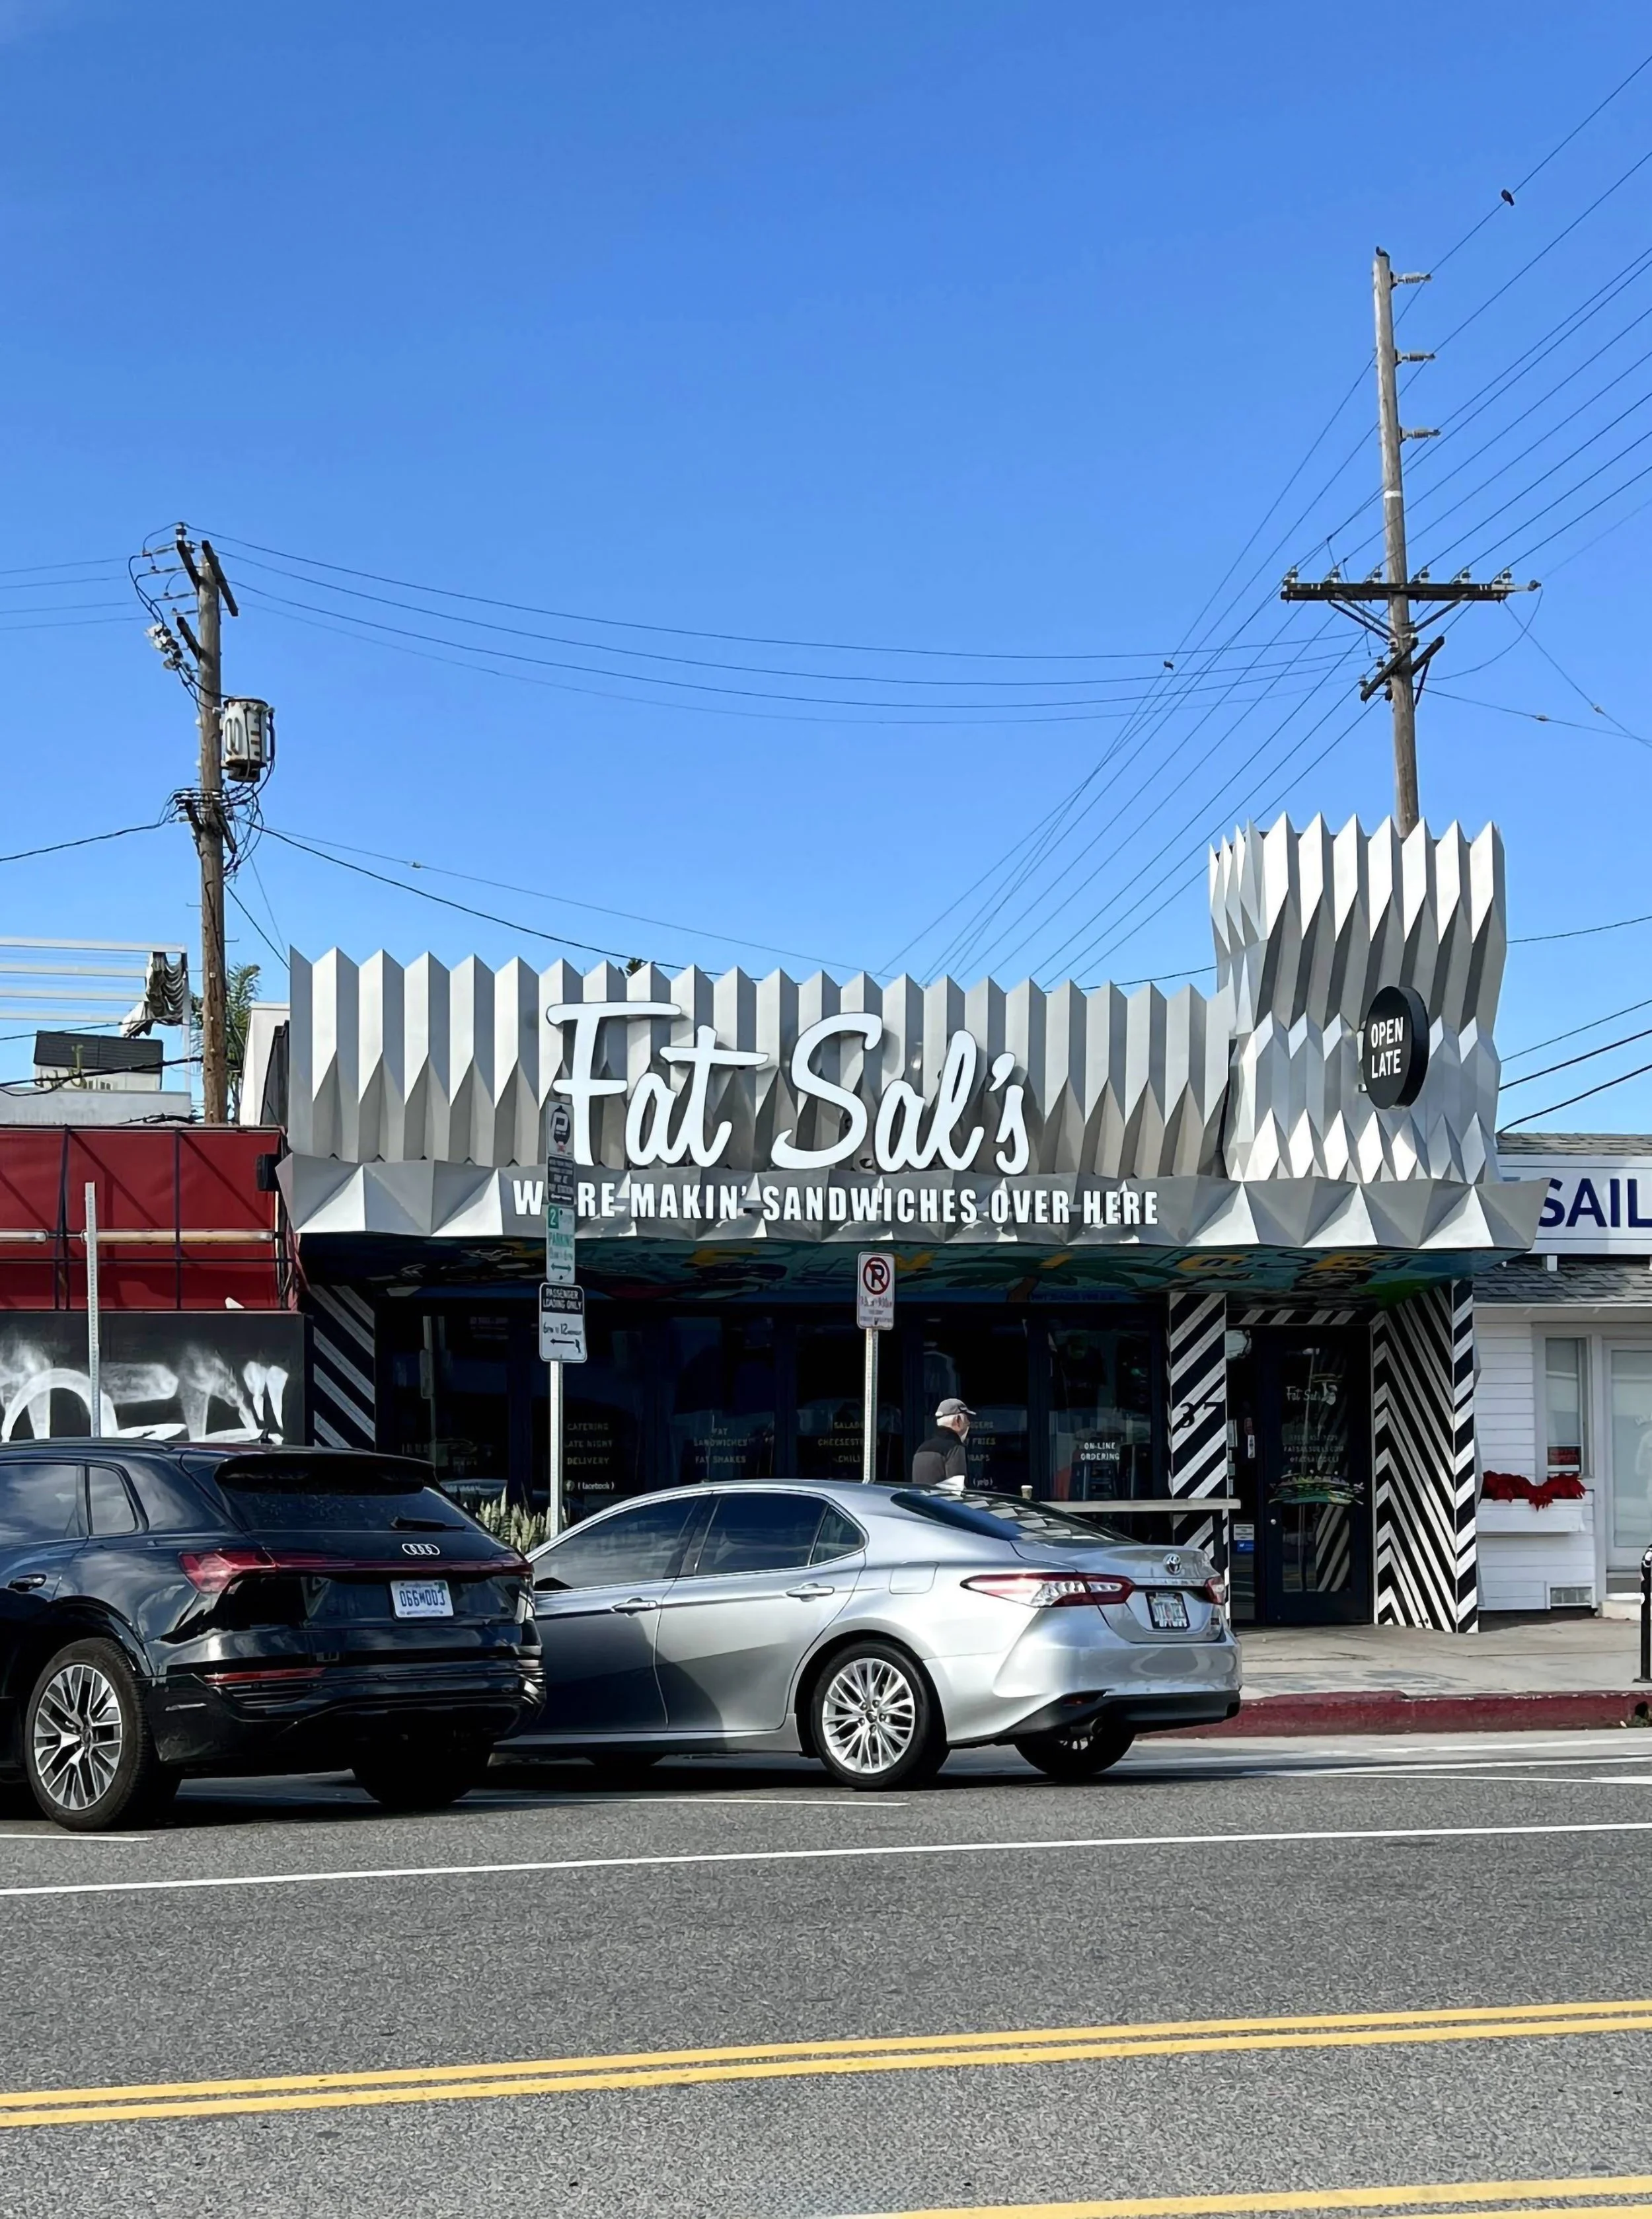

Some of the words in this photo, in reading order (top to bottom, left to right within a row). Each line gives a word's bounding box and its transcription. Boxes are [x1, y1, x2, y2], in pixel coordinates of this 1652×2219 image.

[1371, 1016, 1404, 1047] OPEN
[1371, 1049, 1401, 1078] LATE
[546, 1001, 769, 1168] Fat
[770, 1012, 1031, 1175] Sal's
[513, 1180, 617, 1218] WRE
[631, 1183, 748, 1220] MAKIN'
[763, 1186, 978, 1224] SANDWICHES
[991, 1189, 1069, 1224] OVER
[1084, 1190, 1158, 1225] HERE
[1538, 1178, 1652, 1227] SAIL
[543, 1298, 565, 1308] LOADING
[566, 1300, 582, 1310] ONLY
[546, 1288, 578, 1299] PASSENGER
[1303, 1390, 1321, 1401] Sal
[567, 1456, 609, 1465] DELIVERY
